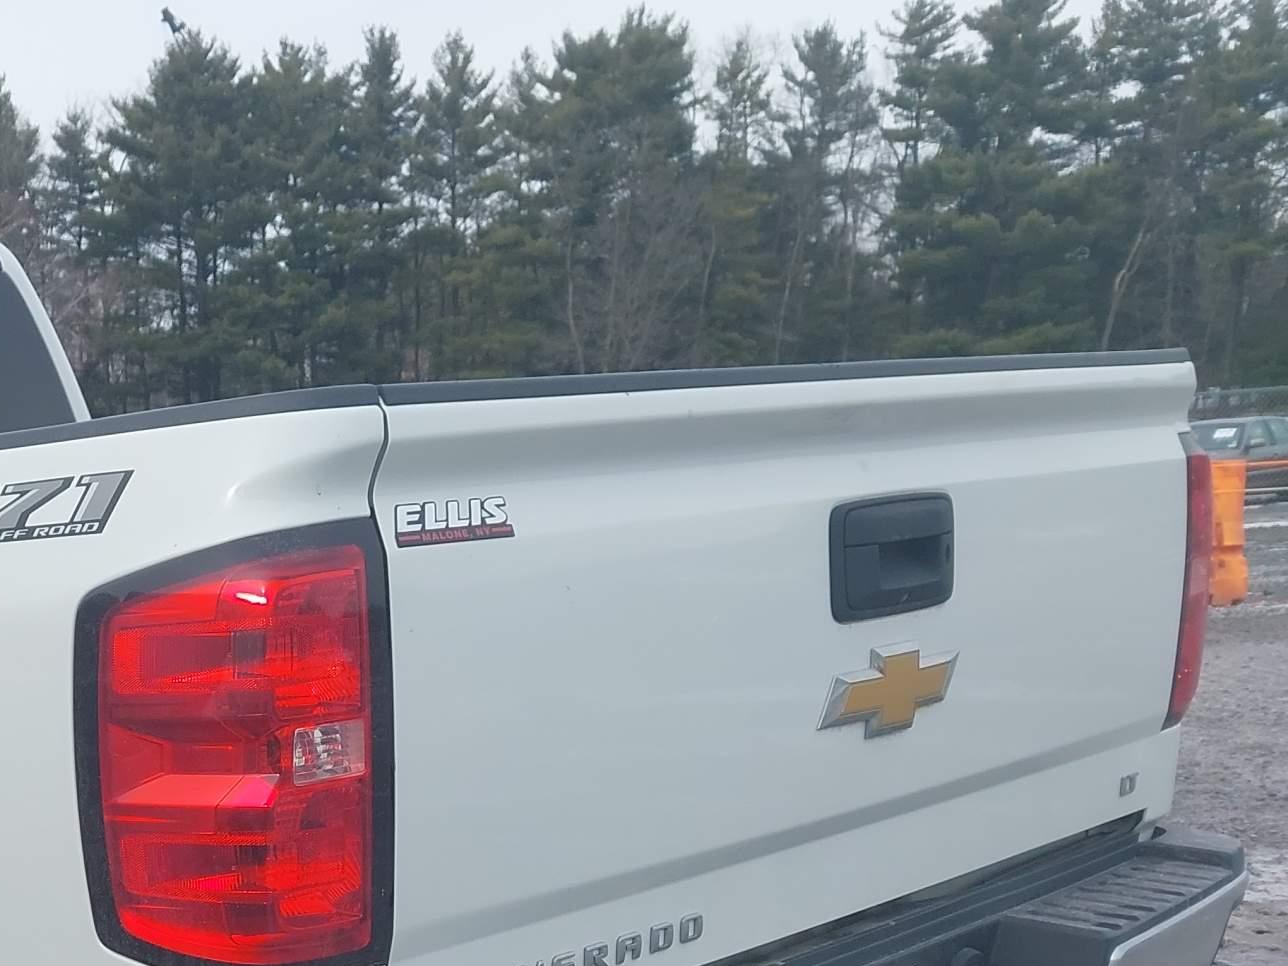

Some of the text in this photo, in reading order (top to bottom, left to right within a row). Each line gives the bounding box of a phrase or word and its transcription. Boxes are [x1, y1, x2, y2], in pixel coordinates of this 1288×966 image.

[394, 496, 508, 533] ELLIS
[32, 521, 100, 538] ROAD
[475, 526, 492, 538] NY
